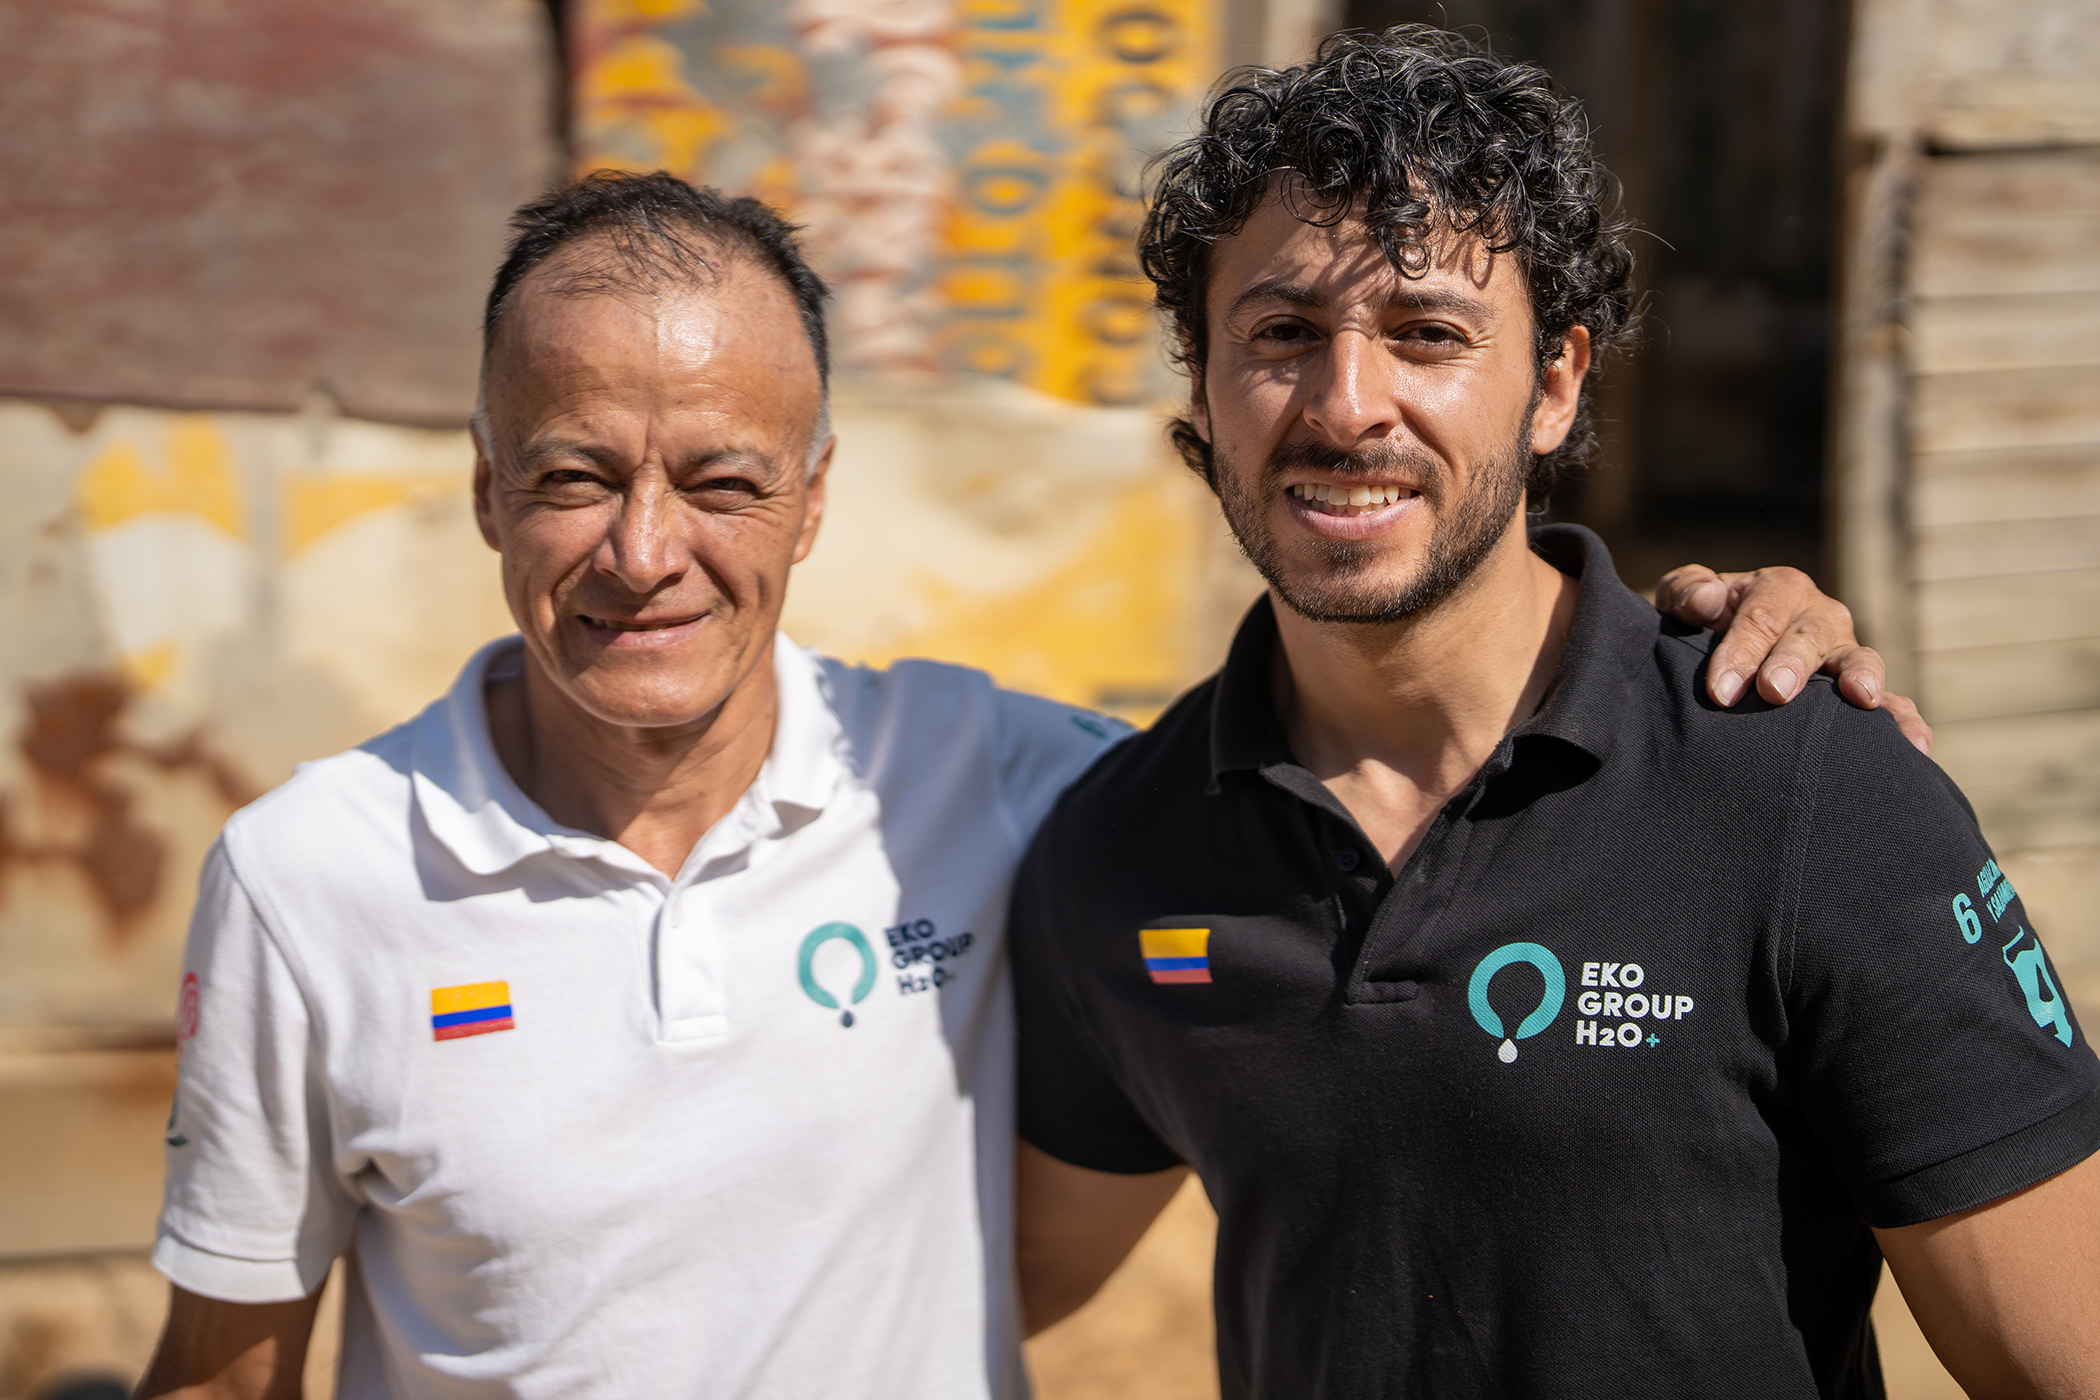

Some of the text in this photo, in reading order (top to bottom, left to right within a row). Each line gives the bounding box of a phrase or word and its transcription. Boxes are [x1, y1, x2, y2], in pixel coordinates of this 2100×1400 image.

[884, 919, 935, 947] EKO
[1952, 892, 1982, 945] 6
[1580, 961, 1645, 989] EKO
[1576, 990, 1694, 1020] GROUP
[1575, 1019, 1661, 1048] H2O+
